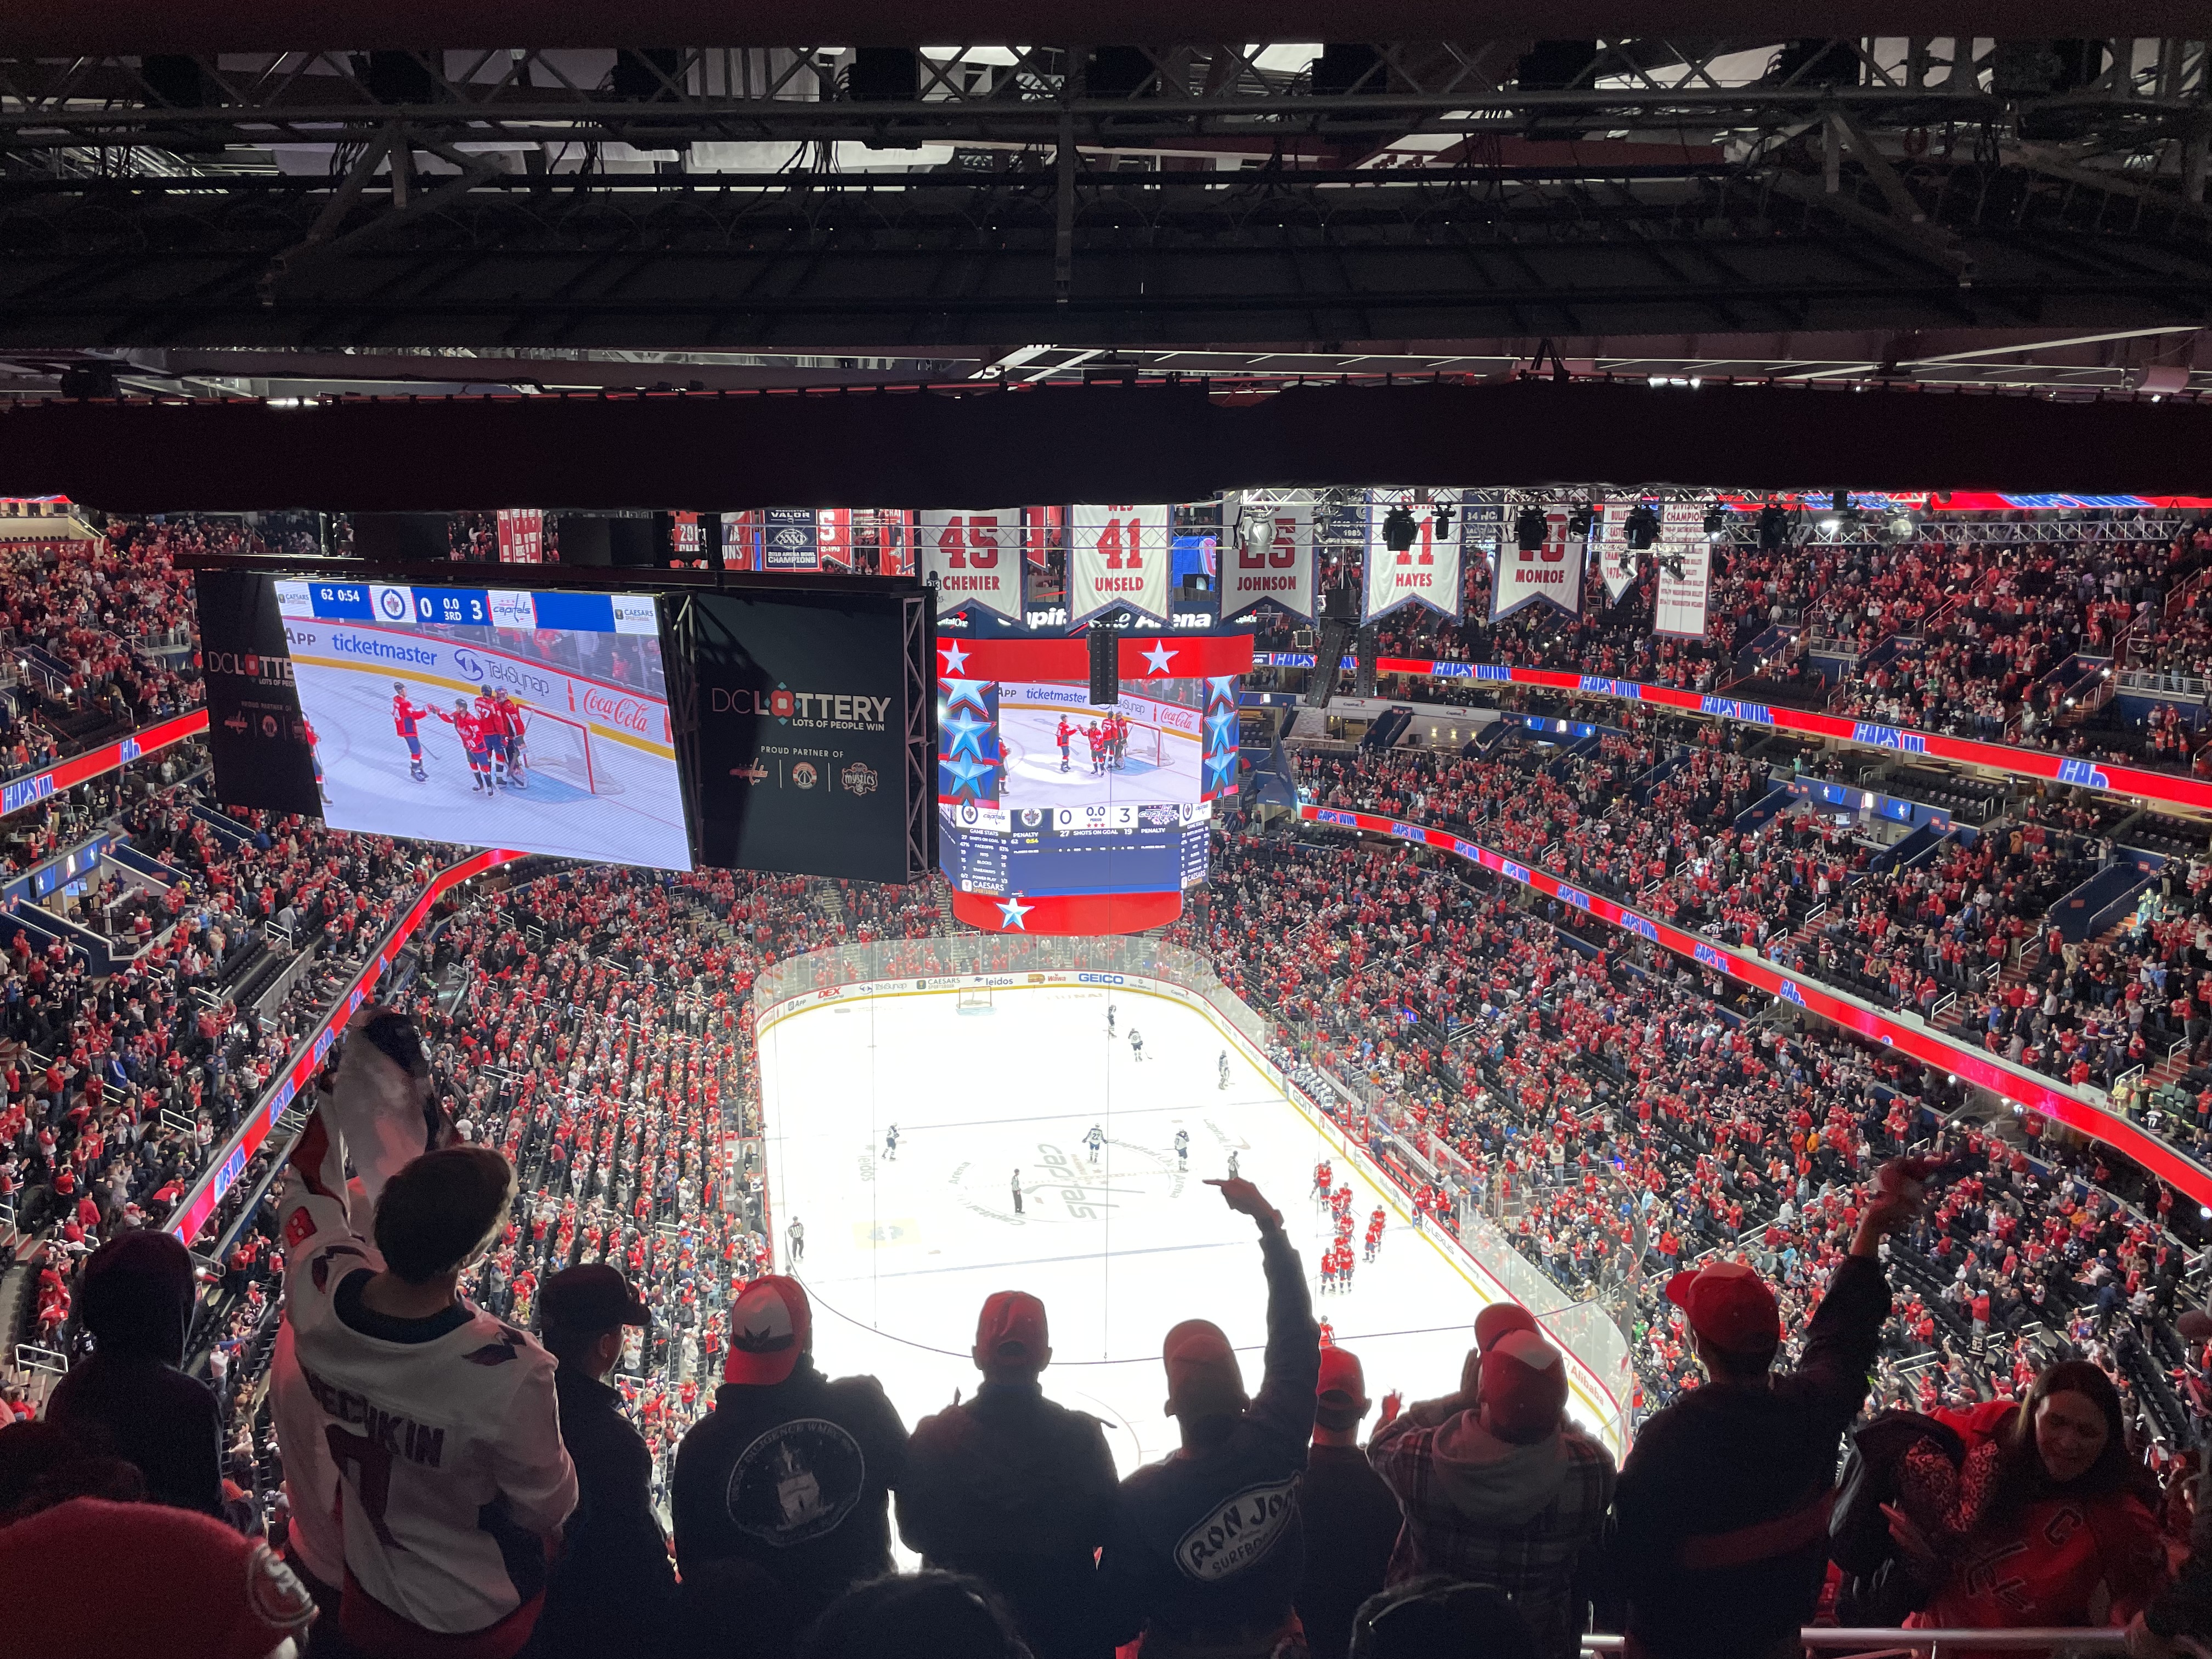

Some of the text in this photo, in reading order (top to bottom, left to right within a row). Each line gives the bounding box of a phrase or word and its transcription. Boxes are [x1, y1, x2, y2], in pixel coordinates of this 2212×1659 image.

[1667, 512, 1705, 522] CHAMPION
[938, 516, 998, 568] 45
[1098, 518, 1143, 568] 41
[943, 575, 1000, 590] CHENIER
[1096, 577, 1144, 591] UNSELD
[1237, 576, 1296, 591] JOHNSON
[1396, 573, 1432, 587] HAYES
[1515, 569, 1565, 583] MONROE
[321, 589, 360, 602] 62 0:54
[420, 597, 432, 618] 0
[443, 598, 460, 610] 0.0
[470, 600, 483, 620] 3
[444, 611, 462, 621] 3RD
[624, 609, 654, 617] CAESARS
[1135, 612, 1211, 628] Aena
[332, 633, 438, 666] ticketmaster
[485, 659, 549, 697] TekSynap
[1026, 688, 1087, 704] ticketmaster
[584, 688, 651, 732] Coca-Cola
[1114, 698, 1146, 715] ekSynap
[792, 719, 884, 731] LOTS OF PEOPLE WIN
[1161, 707, 1194, 730] Coca-Cola
[761, 746, 789, 755] PROUD
[793, 748, 829, 757] PARTNER
[1059, 809, 1072, 825] 0
[1086, 806, 1106, 816] 0.0
[1119, 808, 1131, 823] 3
[1317, 809, 1338, 822] CAPS
[1392, 823, 1409, 837] CAPS
[1455, 839, 1467, 856] CAPS
[1187, 870, 1206, 882] CAESARS
[1502, 860, 1517, 877] CAPS
[973, 881, 1005, 891] CAESARS
[1557, 884, 1574, 904] CAPS
[1621, 912, 1640, 932] CAPS
[1694, 943, 1716, 966] CAPS
[874, 983, 907, 991] TekSynap
[986, 977, 1013, 986] leidos
[1079, 973, 1124, 985] GEICO
[818, 987, 842, 999] DEX
[1293, 1089, 1313, 1115] GDIT
[948, 1161, 971, 1184] Arena
[1170, 1174, 1186, 1198] Arena
[1431, 1227, 1454, 1255] LEXUS
[2044, 1508, 2084, 1547] C
[1190, 1505, 1242, 1570] RON
